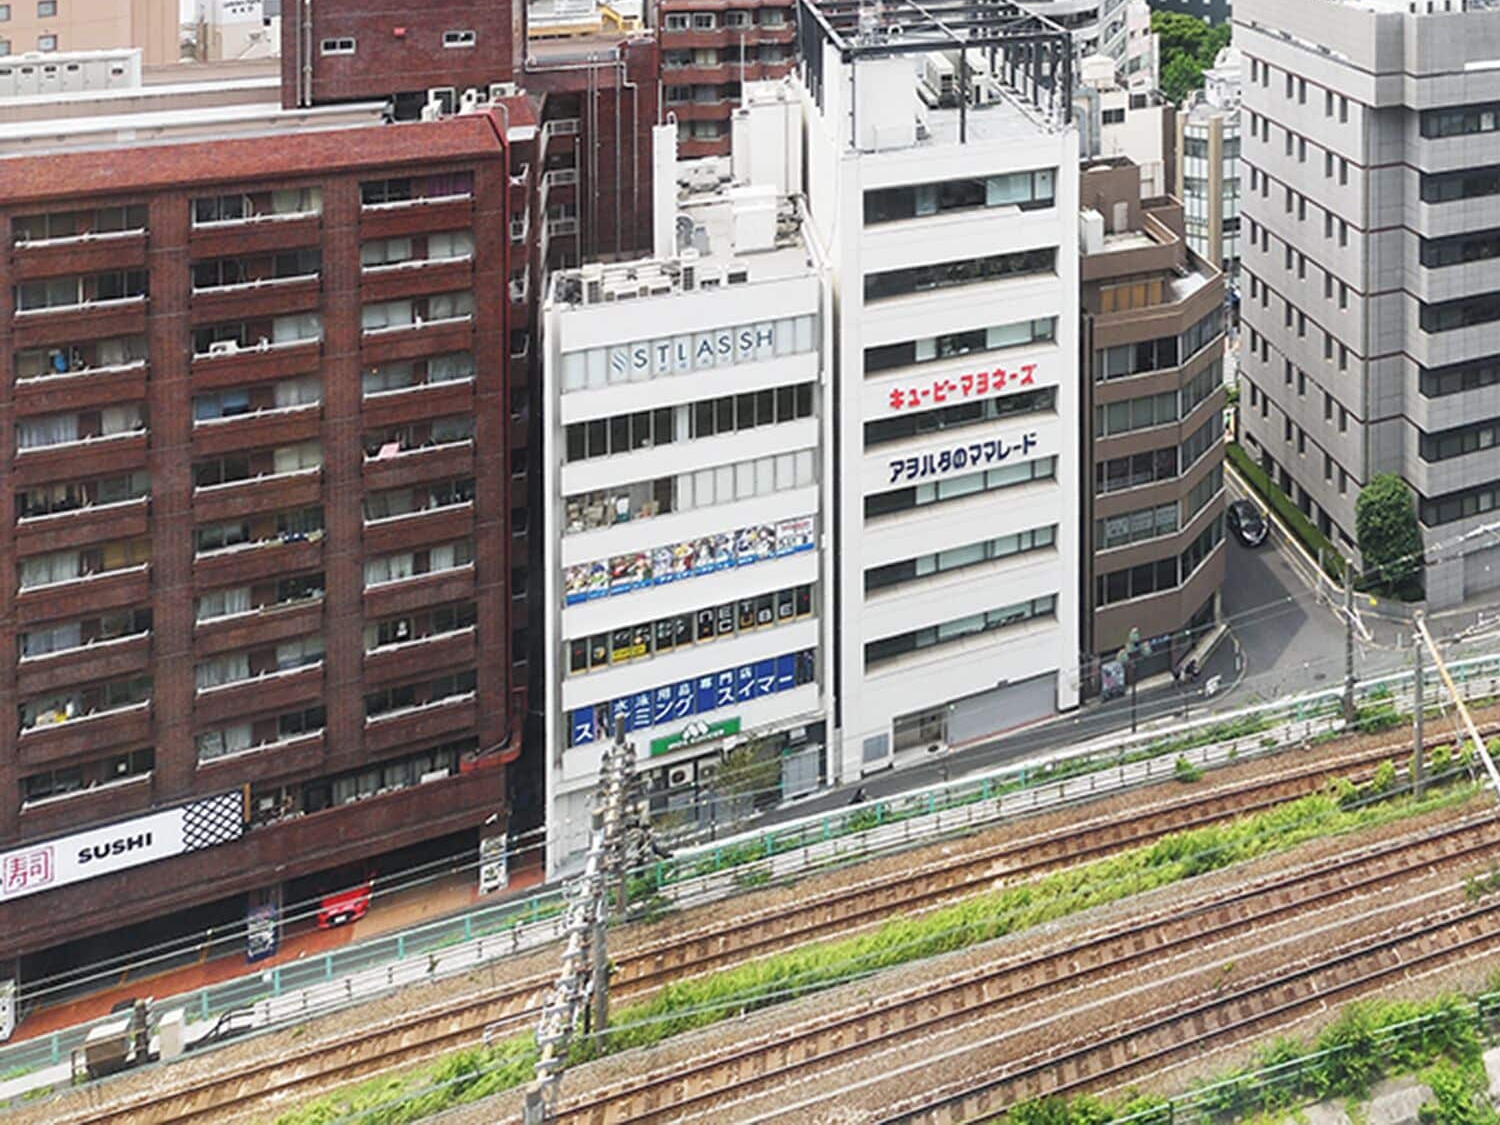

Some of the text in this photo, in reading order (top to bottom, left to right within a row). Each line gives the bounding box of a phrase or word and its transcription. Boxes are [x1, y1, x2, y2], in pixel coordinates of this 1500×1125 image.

[633, 329, 774, 369] STLASSH
[718, 675, 793, 704] スイマー
[8, 832, 153, 888] 寿司 SUSHI
